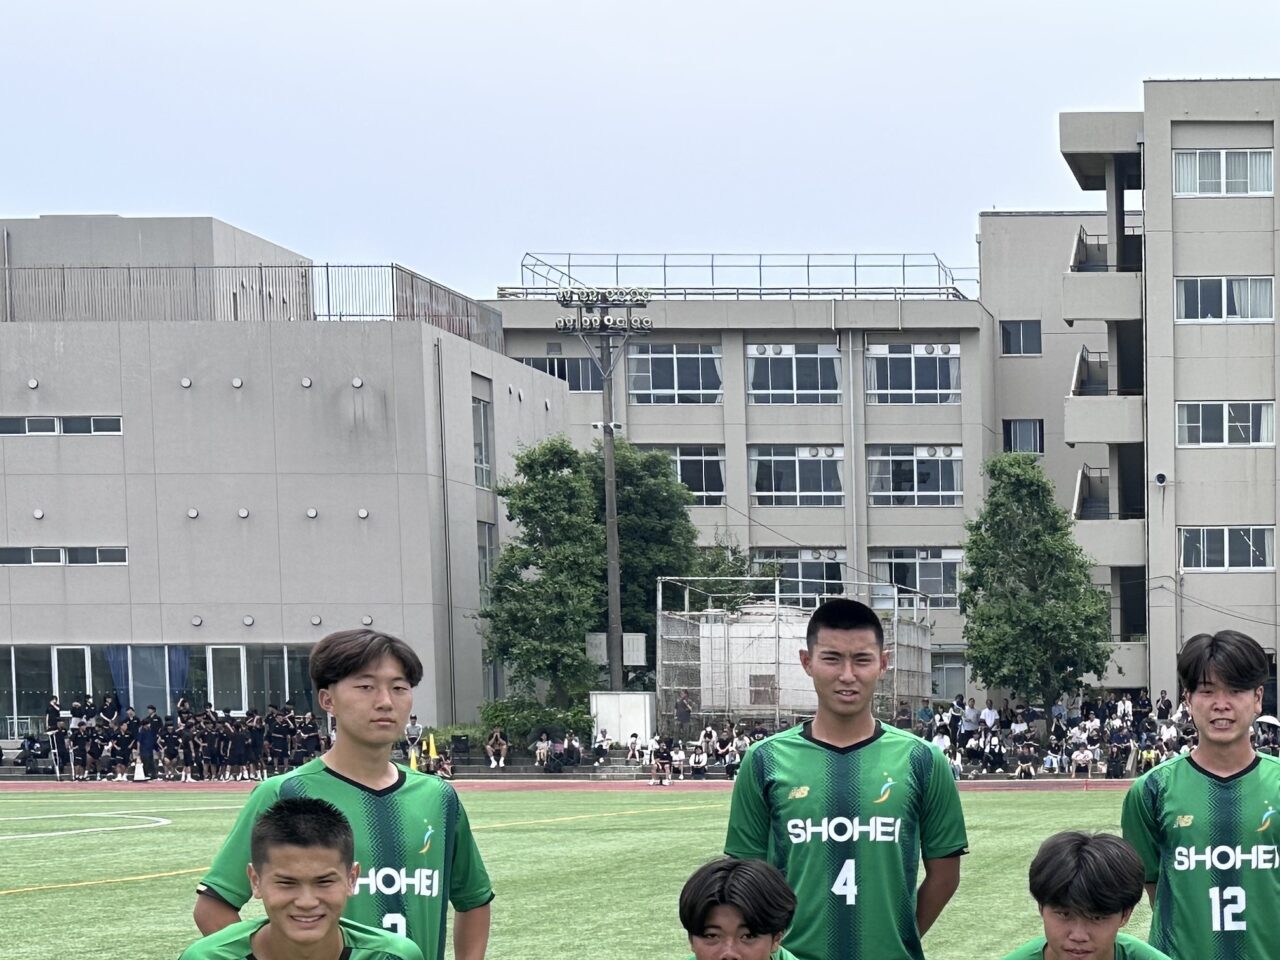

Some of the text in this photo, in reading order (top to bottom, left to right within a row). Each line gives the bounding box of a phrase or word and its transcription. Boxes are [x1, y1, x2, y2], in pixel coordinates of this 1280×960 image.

[786, 816, 902, 844] SHOHEI
[1173, 844, 1280, 871] SHOHEI
[353, 866, 440, 897] HOHEI
[830, 858, 858, 905] 4
[1208, 886, 1247, 932] 12
